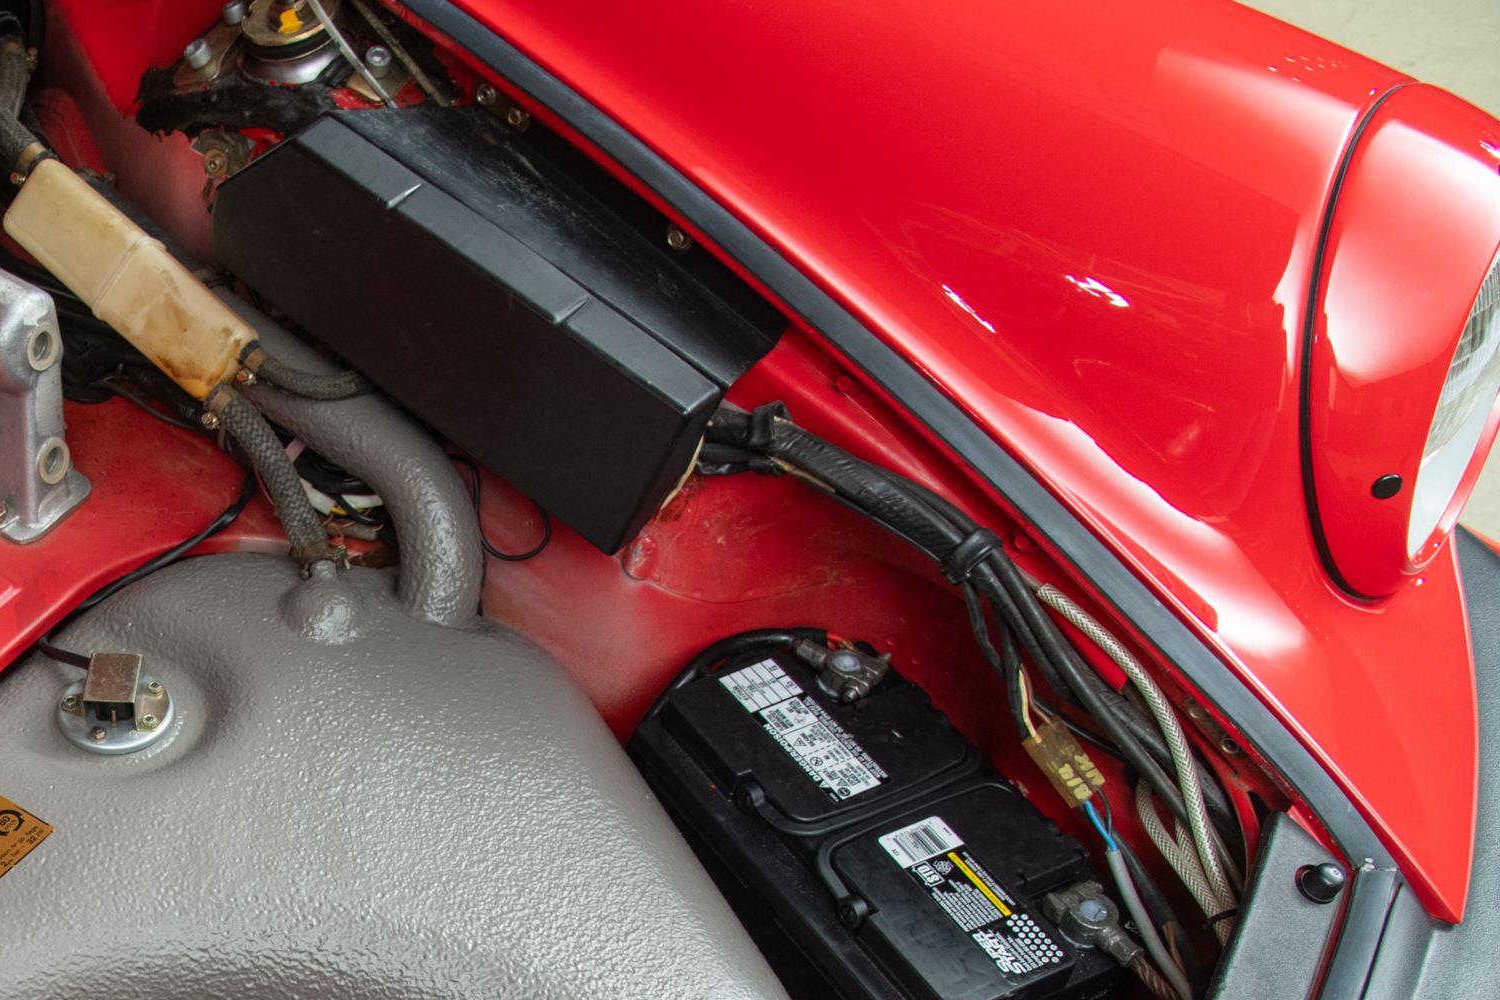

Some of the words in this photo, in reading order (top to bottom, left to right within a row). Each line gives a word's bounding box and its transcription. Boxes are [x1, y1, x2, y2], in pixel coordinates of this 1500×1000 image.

[762, 723, 824, 782] DANGER/POISON
[25, 834, 38, 844] 32
[917, 864, 941, 883] STD
[972, 931, 1011, 972] SUPER
[978, 929, 1027, 975] START
